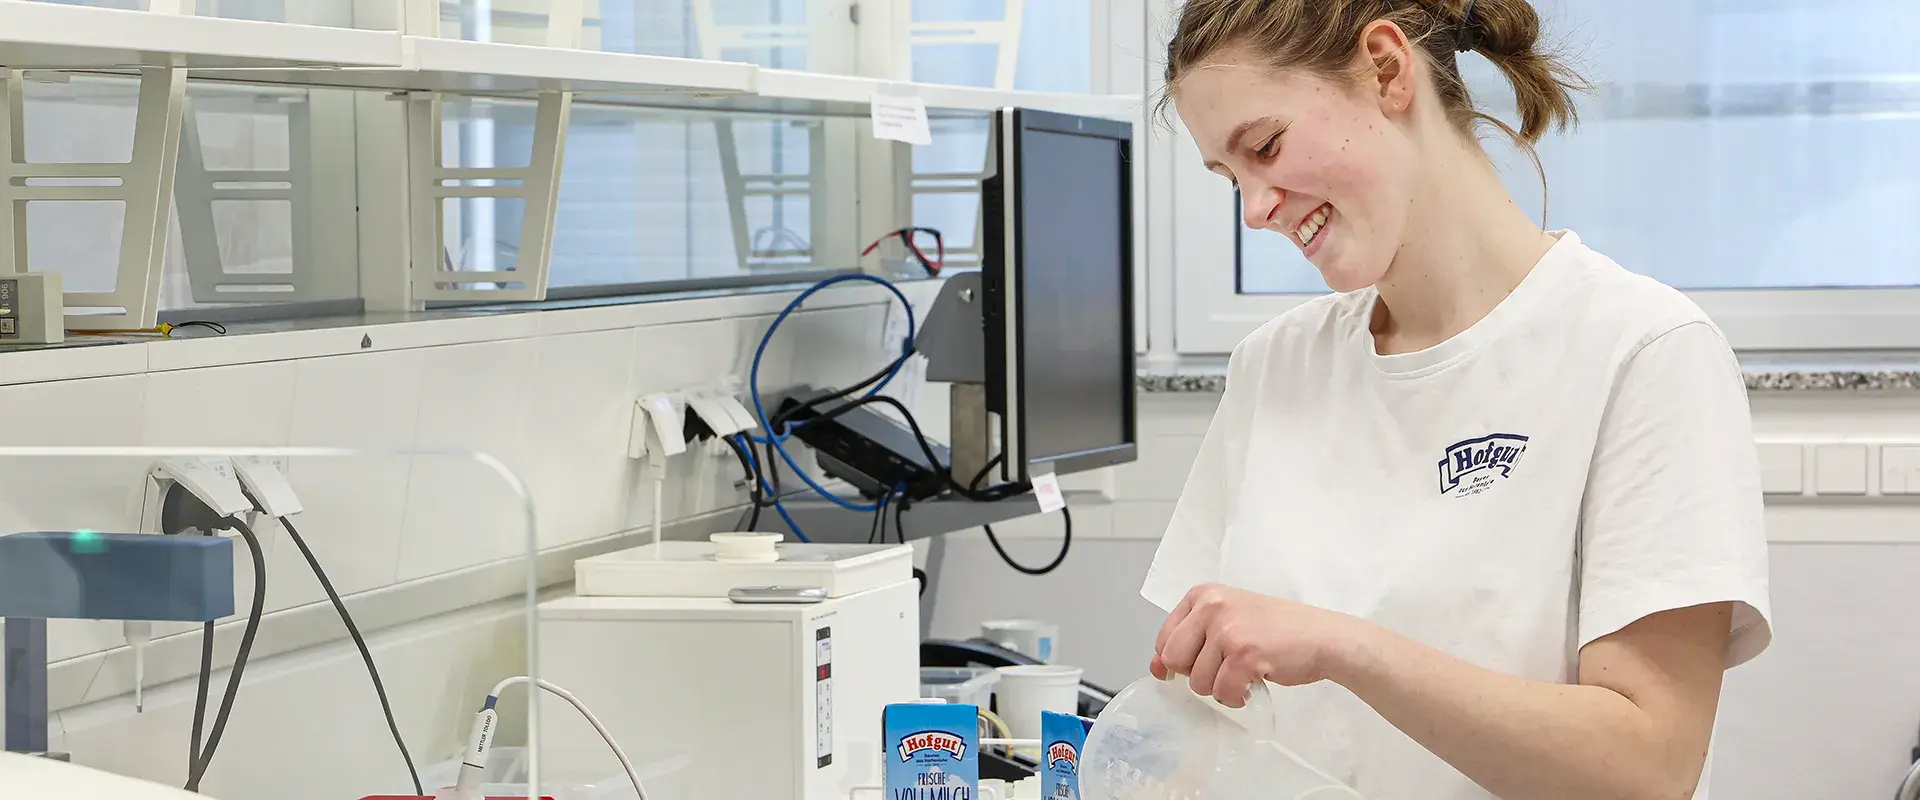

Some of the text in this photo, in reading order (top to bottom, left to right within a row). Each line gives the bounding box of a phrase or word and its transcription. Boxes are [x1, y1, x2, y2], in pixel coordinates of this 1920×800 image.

[906, 734, 959, 751] Hofgut
[1052, 745, 1075, 763] Hofgut
[917, 772, 946, 786] FRISCHE
